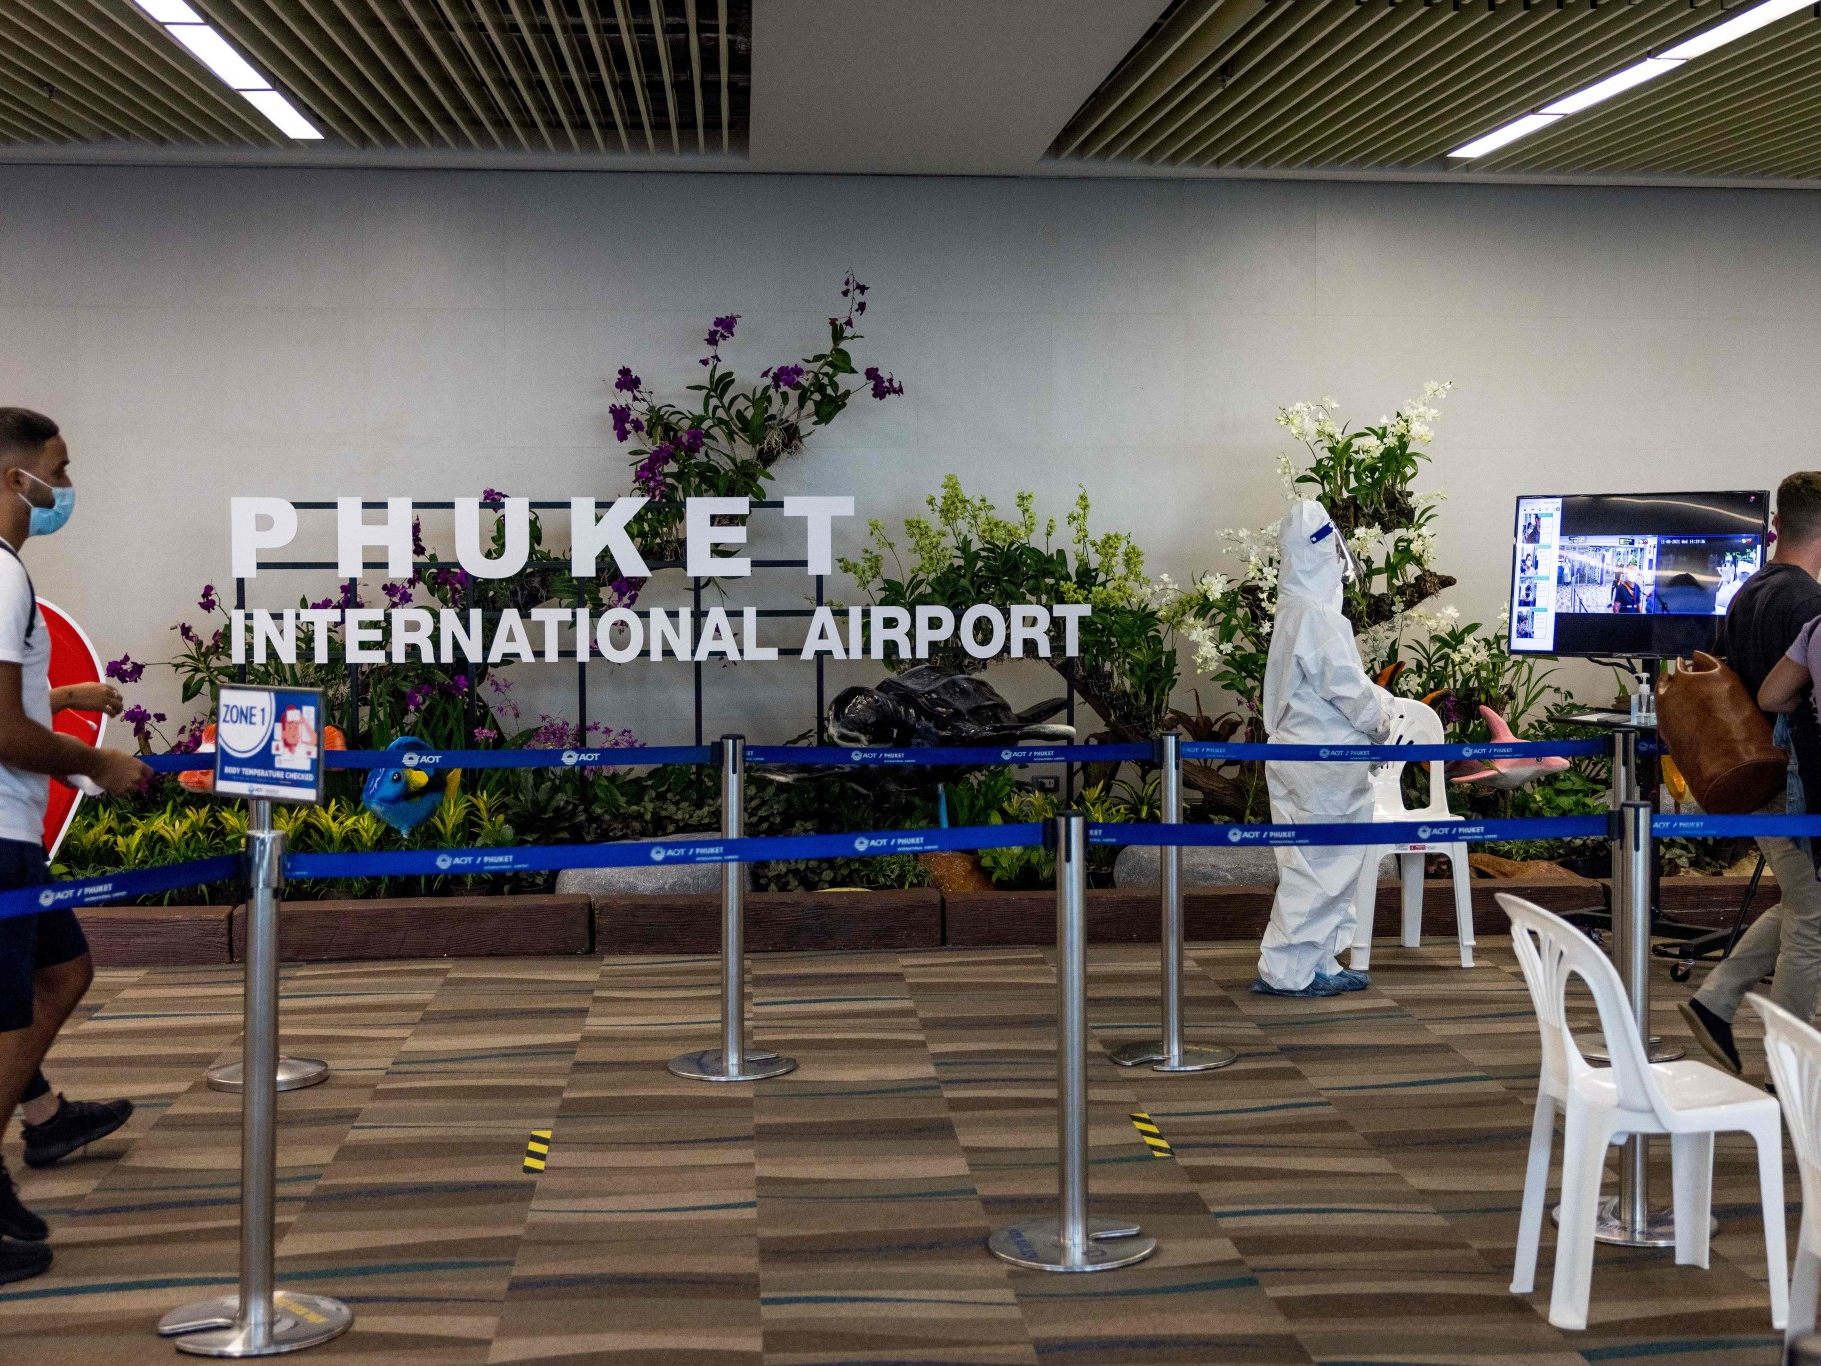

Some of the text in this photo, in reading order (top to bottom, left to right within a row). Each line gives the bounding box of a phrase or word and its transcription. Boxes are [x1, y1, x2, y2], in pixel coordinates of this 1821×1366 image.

[231, 496, 855, 578] PHUKET
[231, 604, 1092, 664] INTERNATIONAL AIRPORT
[222, 704, 266, 727] ZONE 1
[420, 755, 442, 764] AOT
[578, 753, 600, 762] AOT
[241, 768, 285, 779] TEMPERATURE
[1269, 830, 1296, 838] PHUKET
[1458, 826, 1485, 834] PHUKET
[869, 838, 888, 846] AOT
[897, 836, 925, 845] PHUKET
[666, 848, 686, 856] AOT
[695, 846, 724, 855] PHUKET
[453, 856, 474, 865] AOT
[483, 855, 513, 863] PHUKET
[55, 889, 75, 900] AOT
[84, 883, 113, 895] PHUKET
